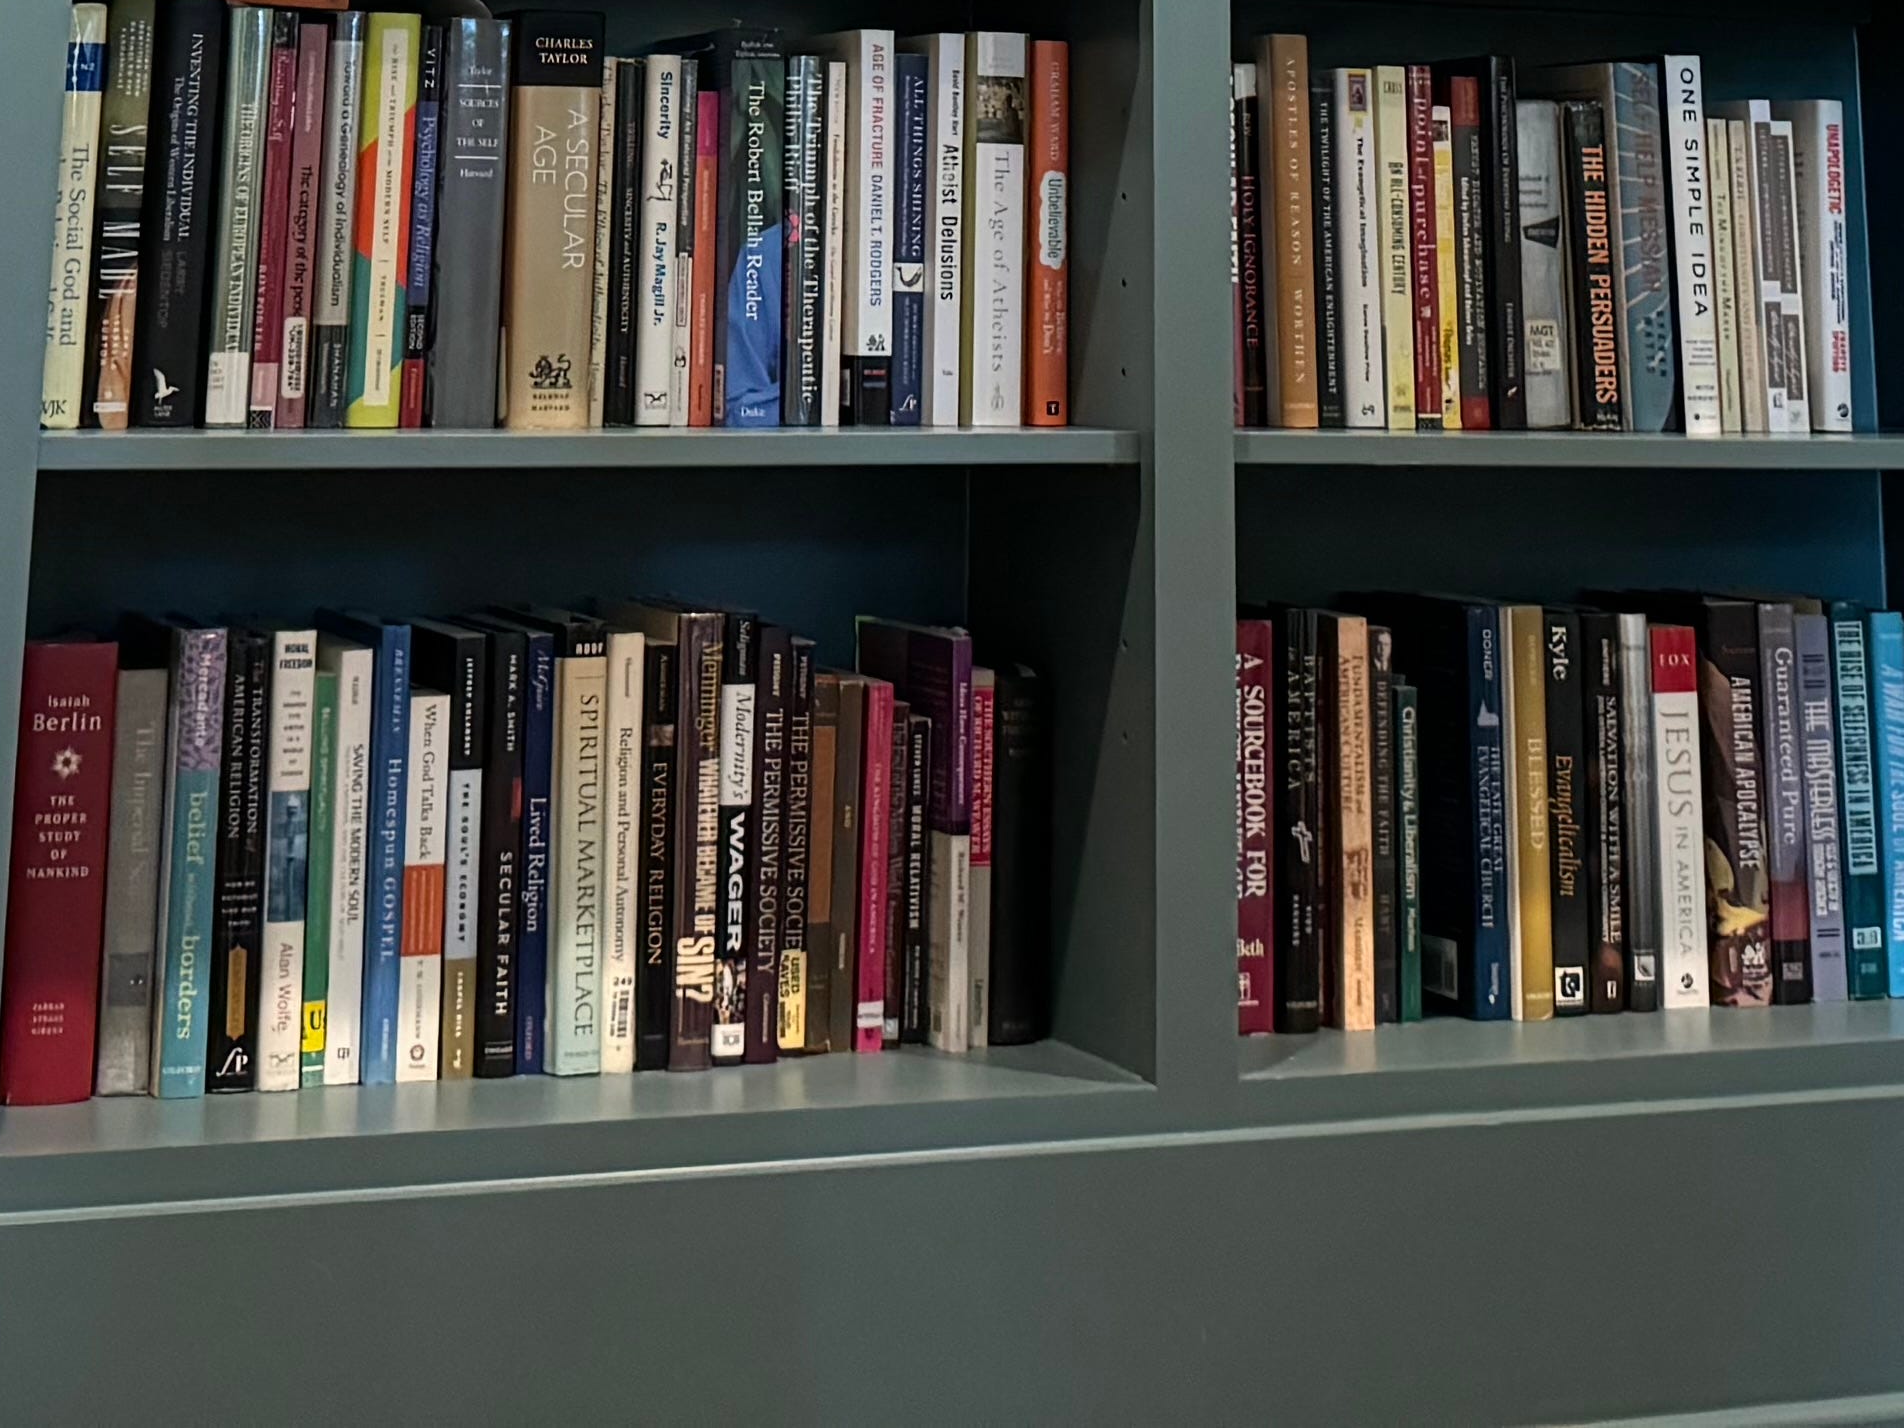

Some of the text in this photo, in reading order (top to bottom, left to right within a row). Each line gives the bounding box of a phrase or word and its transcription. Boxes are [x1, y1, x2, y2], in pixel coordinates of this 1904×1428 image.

[535, 37, 593, 50] CHARLES
[539, 51, 589, 65] TAYLOR
[657, 71, 673, 139] Sincerity
[531, 125, 556, 185] AGE
[561, 138, 590, 270] SECULAR
[939, 144, 960, 301] Atheist Delusions
[1679, 68, 1707, 317] ONE SIMPLE IDEA
[1581, 144, 1617, 404] THE HIDDEN PERSUADERS
[1552, 625, 1569, 681] Kyle
[33, 713, 102, 731] Berlin
[47, 695, 91, 708] Isaiah
[34, 812, 87, 824] PROPER
[38, 830, 80, 842] STUDY
[1546, 755, 1582, 897] Evangelicalism
[1660, 711, 1693, 956] JESUS IN AMERICA
[726, 813, 745, 952] WAGER
[675, 938, 715, 1003] SIN?
